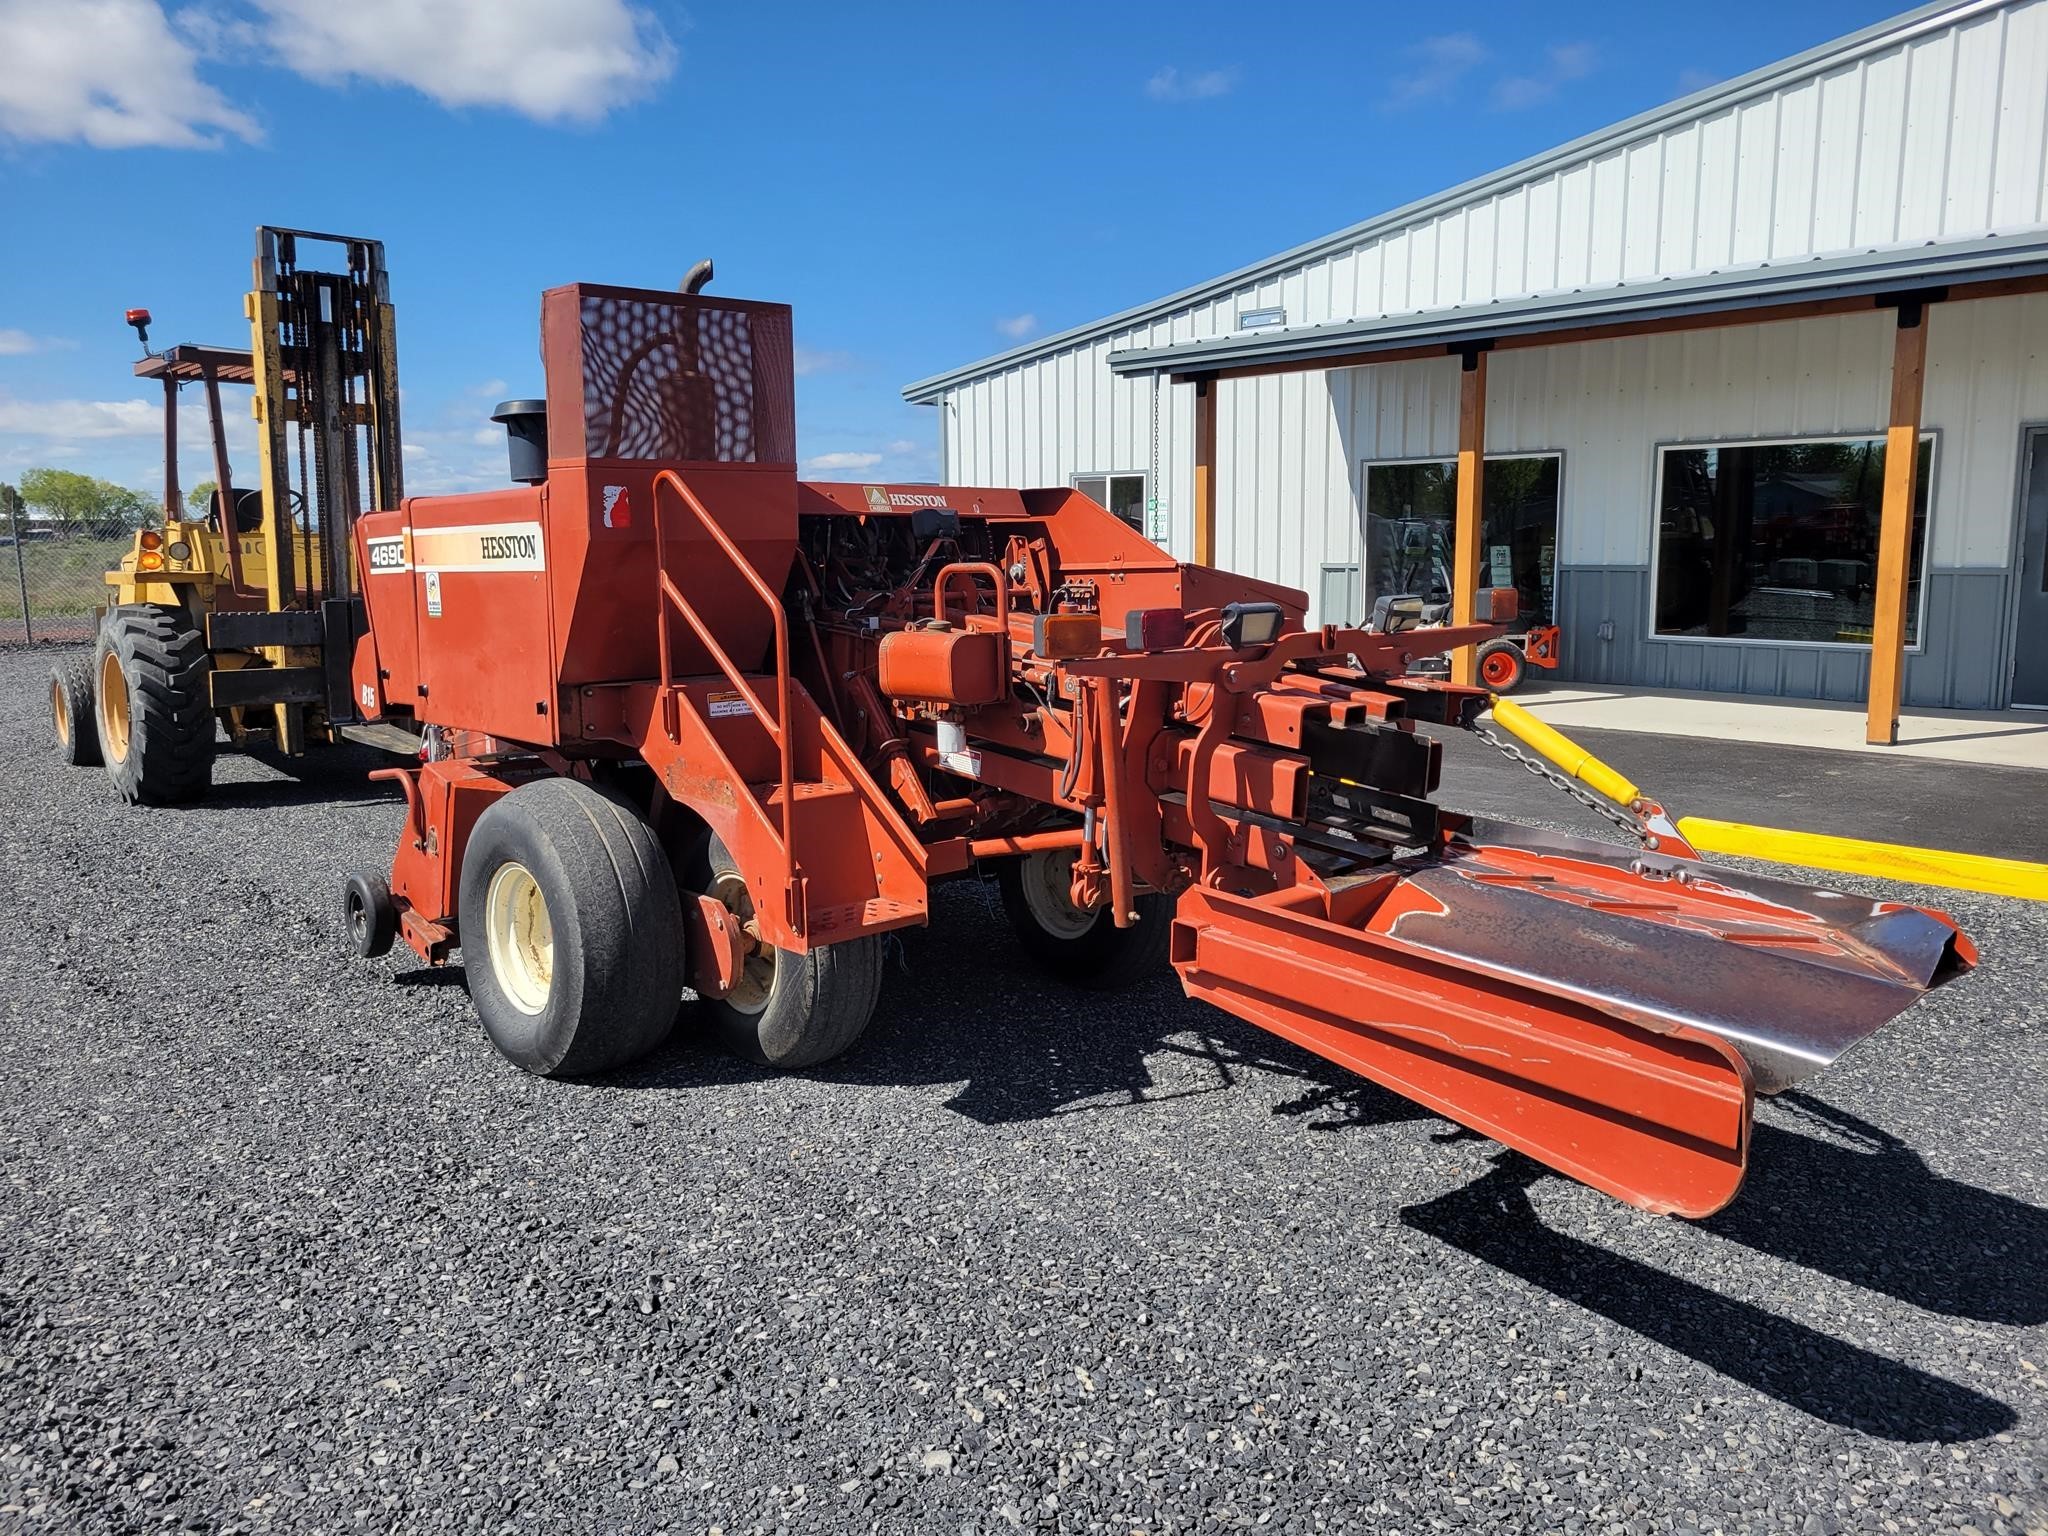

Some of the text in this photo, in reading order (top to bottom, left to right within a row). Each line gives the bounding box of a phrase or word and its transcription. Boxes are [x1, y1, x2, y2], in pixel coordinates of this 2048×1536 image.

[888, 494, 948, 507] HESSTON
[371, 544, 405, 566] 4690
[480, 534, 536, 560] HESSTON
